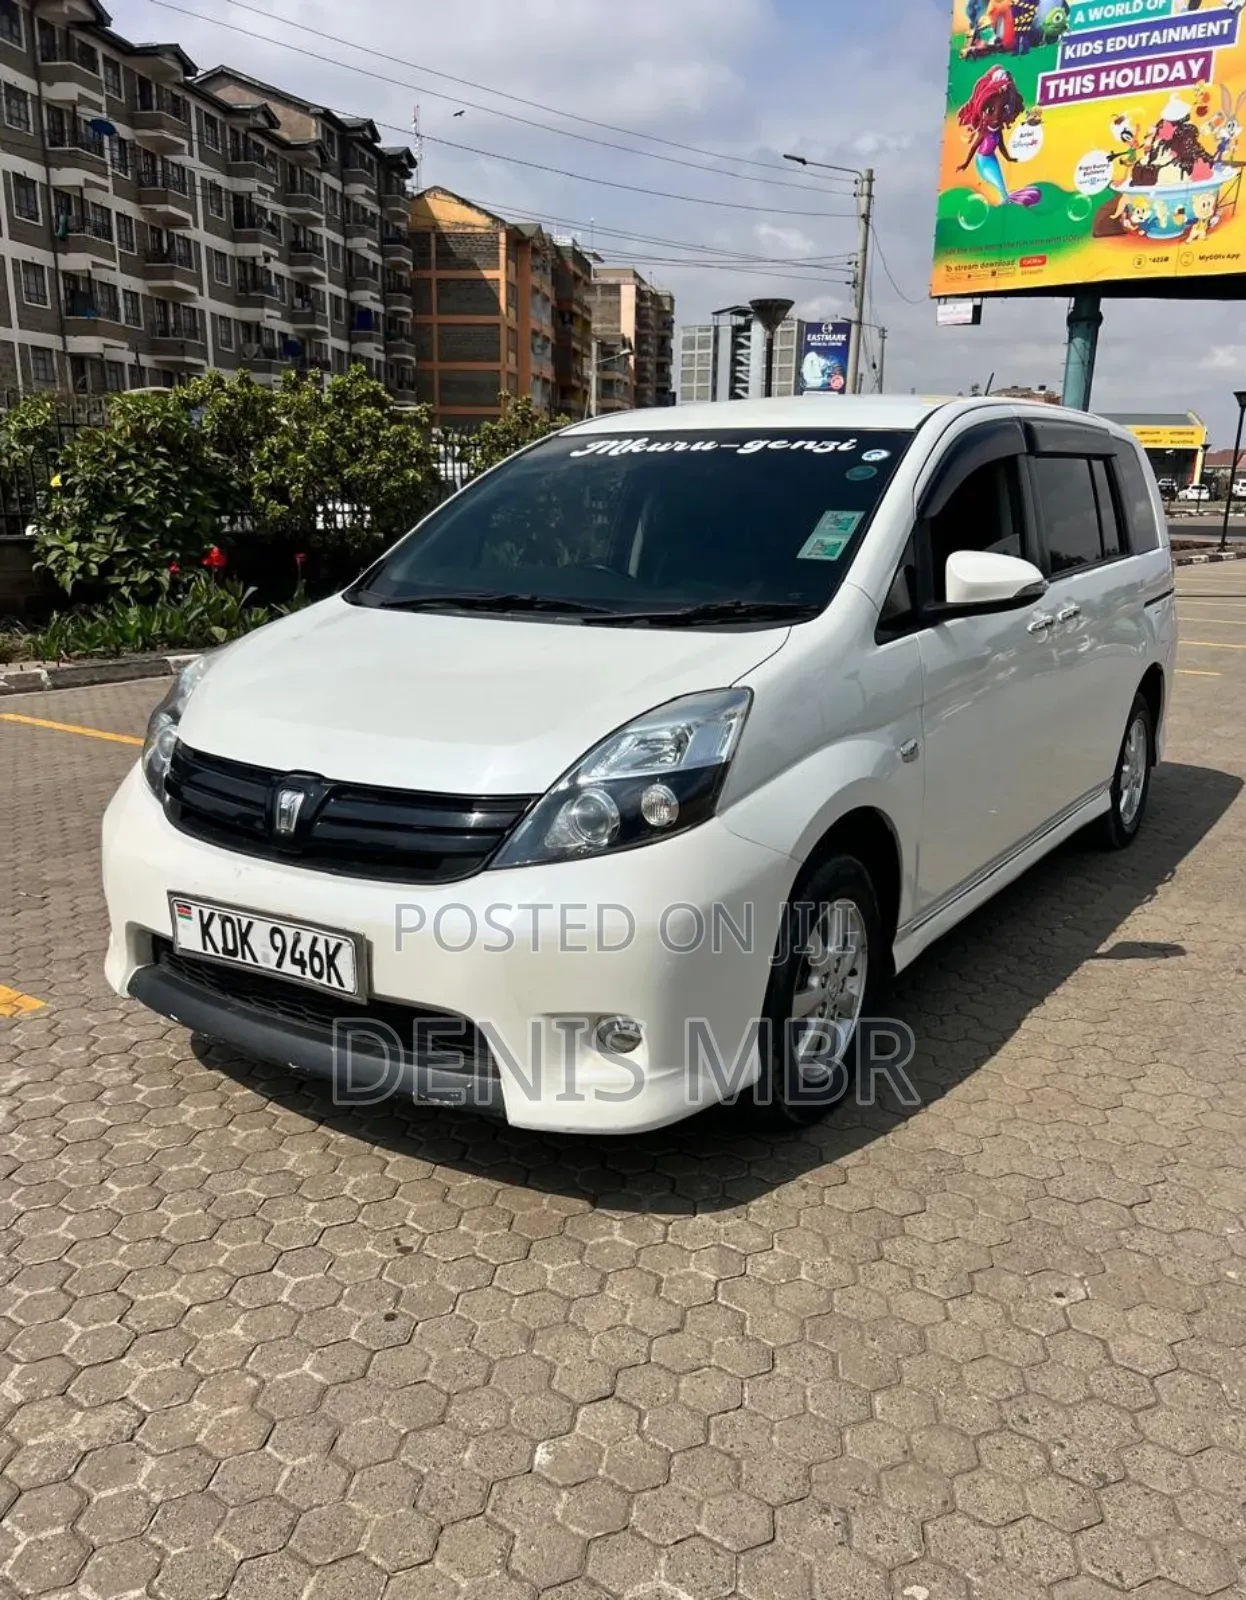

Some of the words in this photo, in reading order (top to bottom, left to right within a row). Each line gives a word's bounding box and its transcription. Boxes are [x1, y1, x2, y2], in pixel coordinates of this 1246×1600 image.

[1073, 10, 1085, 24] A
[1088, 0, 1144, 21] WORLD
[1146, 0, 1167, 11] OF
[1064, 41, 1106, 60] KIDS
[1106, 19, 1232, 52] EDUTAINMENT
[1046, 74, 1096, 99] THIS
[1100, 57, 1205, 91] HOLIDAY
[944, 264, 953, 272] To
[954, 263, 978, 272] stream
[980, 259, 1016, 269] download
[198, 908, 259, 964] KDK
[269, 926, 345, 988] 946K
